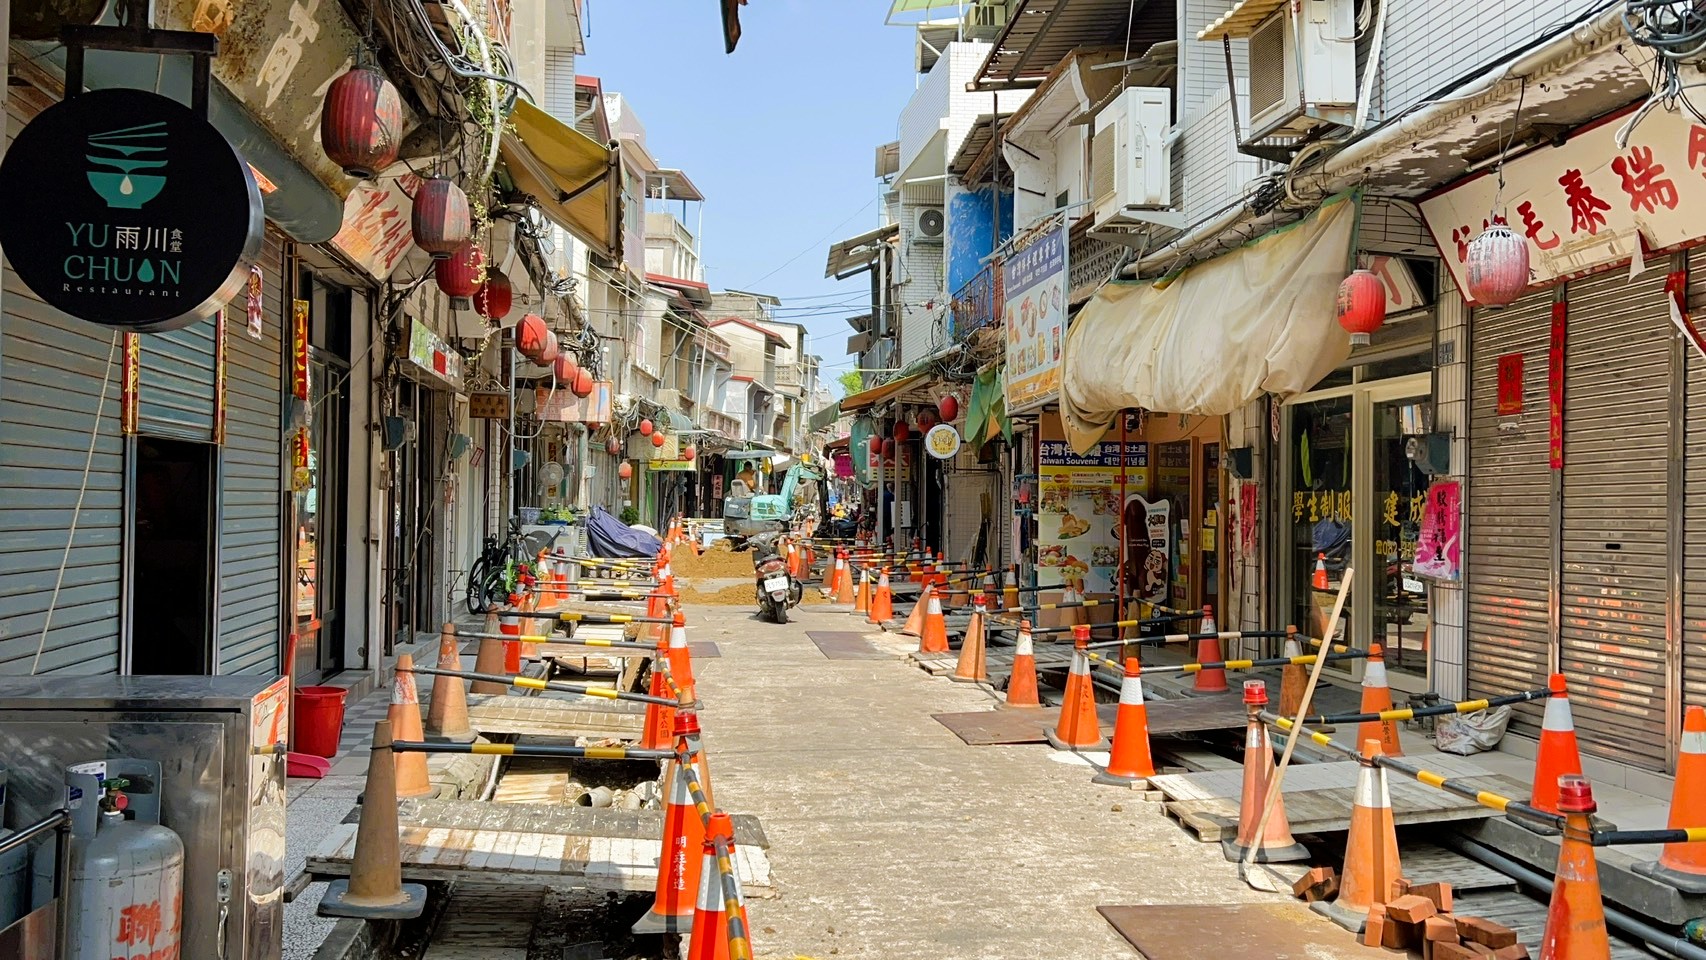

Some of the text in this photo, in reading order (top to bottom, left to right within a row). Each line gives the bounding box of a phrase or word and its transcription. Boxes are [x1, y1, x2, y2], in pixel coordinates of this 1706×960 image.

[65, 222, 109, 248] YU
[115, 226, 168, 252] 雨川
[169, 228, 183, 253] 食堂
[63, 283, 180, 297] Restaurant
[1040, 457, 1100, 466] Taiwan Souvenir
[1292, 489, 1353, 524] 學生制服
